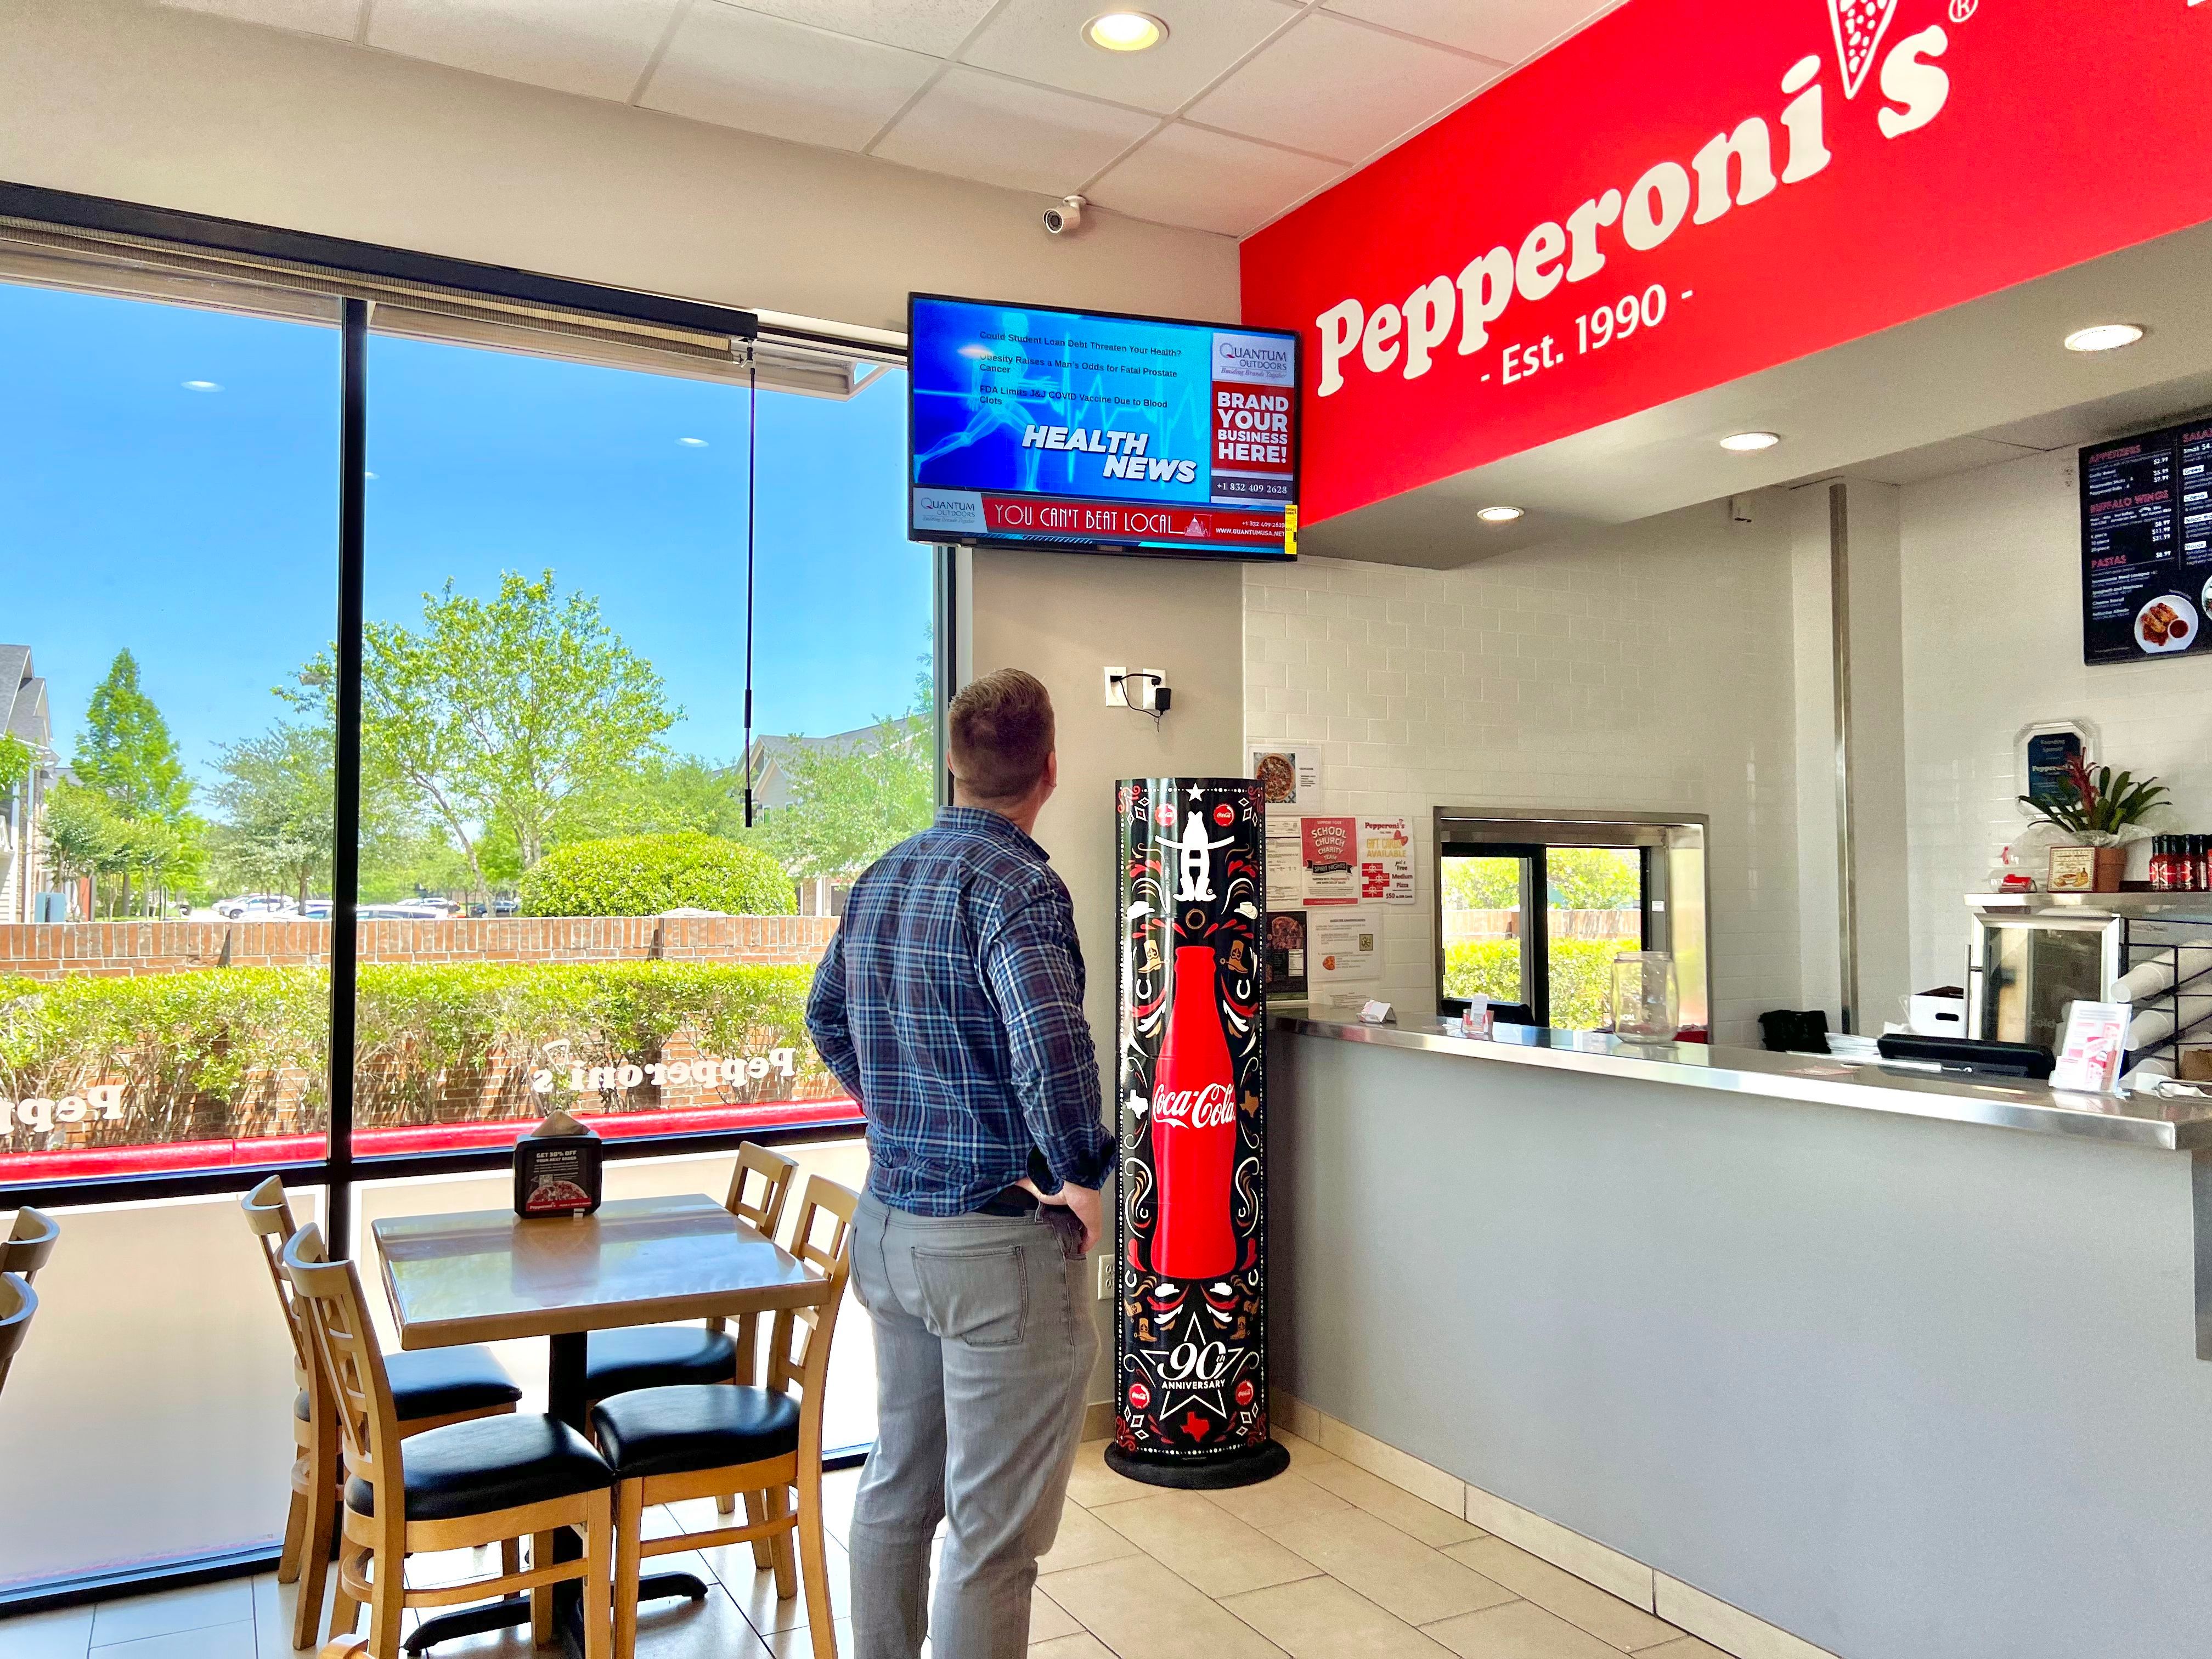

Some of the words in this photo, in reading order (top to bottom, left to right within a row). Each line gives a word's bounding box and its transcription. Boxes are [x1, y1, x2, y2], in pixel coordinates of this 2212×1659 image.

[1316, 0, 1949, 397] Pepperoni's
[1502, 334, 1564, 385] Est.
[1575, 284, 1667, 354] 1990
[979, 331, 1006, 341] Could
[1008, 334, 1042, 345] Student
[1044, 337, 1065, 346] Loan
[1068, 339, 1087, 348] Debt
[1090, 341, 1127, 352] Threaten
[1129, 345, 1148, 354] Your
[1150, 347, 1181, 357] Health?
[1219, 342, 1287, 362] QUANTUM
[979, 364, 1011, 374] Cancer
[1015, 356, 1045, 366] Raises
[1054, 359, 1079, 369] Man's
[1081, 362, 1104, 371] Odds
[1107, 364, 1119, 373] for
[1120, 365, 1141, 375] Fatal
[1143, 367, 1177, 378] Prostate
[1239, 359, 1287, 371] OUTDOORS
[979, 385, 998, 393] FDA
[1000, 386, 1027, 397] Limits
[1029, 389, 1046, 398] J&J
[1048, 391, 1076, 400] COVID
[1079, 394, 1111, 404] Vaccine
[1114, 397, 1130, 405] Due
[1143, 399, 1167, 408] Blood
[979, 396, 1003, 405] Clots
[1217, 391, 1289, 412] BRAND
[1217, 409, 1288, 432] YOUR
[1022, 424, 1149, 456] HEALTH
[1217, 429, 1288, 445] BUSINESS
[1218, 442, 1287, 464] HERE!
[1102, 454, 1197, 483] NEWS
[1216, 482, 1227, 490] +1
[1229, 483, 1246, 492] 832
[1248, 484, 1264, 492] 409
[1267, 485, 1287, 494] 2628
[921, 497, 975, 511] QUANTUM
[936, 509, 975, 518] OUTDOORS
[995, 504, 1032, 526] YOU
[1040, 507, 1079, 528] CAN'T
[1086, 510, 1118, 531] BEAT
[1124, 512, 1185, 534] LOCAL
[1215, 527, 1285, 537] WWW.QUANTUMUSA.NET
[2091, 555, 2127, 569] PASTAS
[1311, 826, 1347, 839] SCHOOL
[1315, 837, 1345, 847] CHURCH
[1318, 847, 1344, 855] CHARITY
[1367, 850, 1407, 858] AVAILABLE
[1328, 862, 1346, 871] NIGHTS
[1153, 1083, 1235, 1129] Coca-Cola
[1161, 1379, 1226, 1390] ANNIVERSARY
